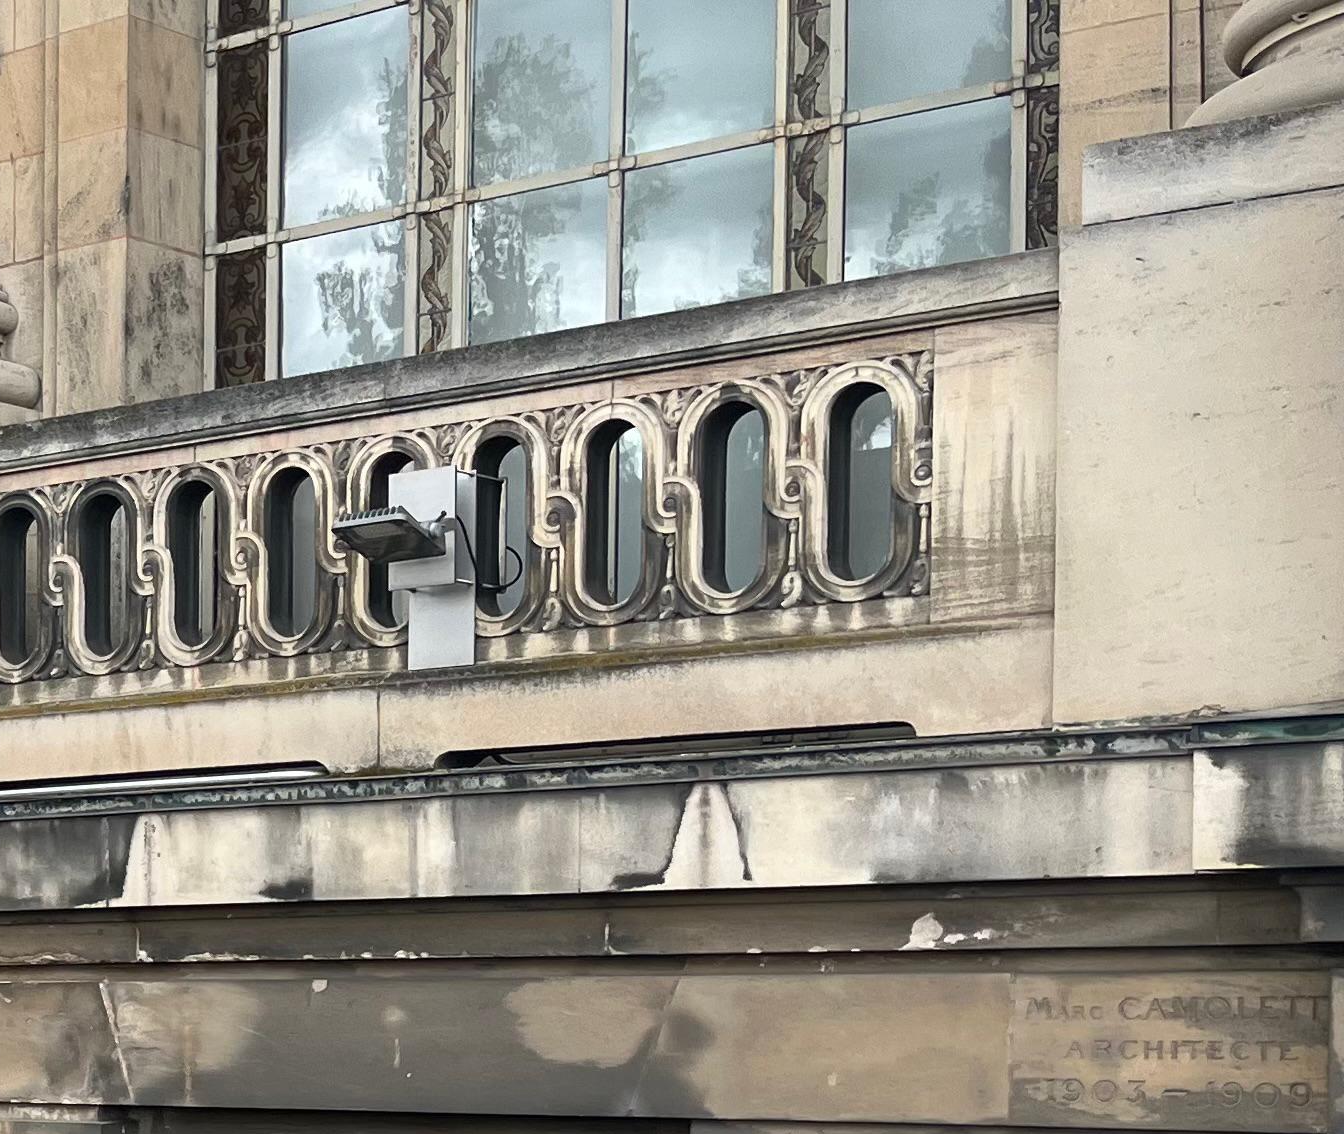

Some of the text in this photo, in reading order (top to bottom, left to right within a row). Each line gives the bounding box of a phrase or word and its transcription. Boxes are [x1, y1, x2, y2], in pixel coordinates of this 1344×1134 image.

[1118, 995, 1328, 1021] CAMOLETT
[1064, 1040, 1300, 1061] ARCHITECTE
[1047, 1078, 1147, 1103] 1903
[1207, 1080, 1313, 1107] 1909
